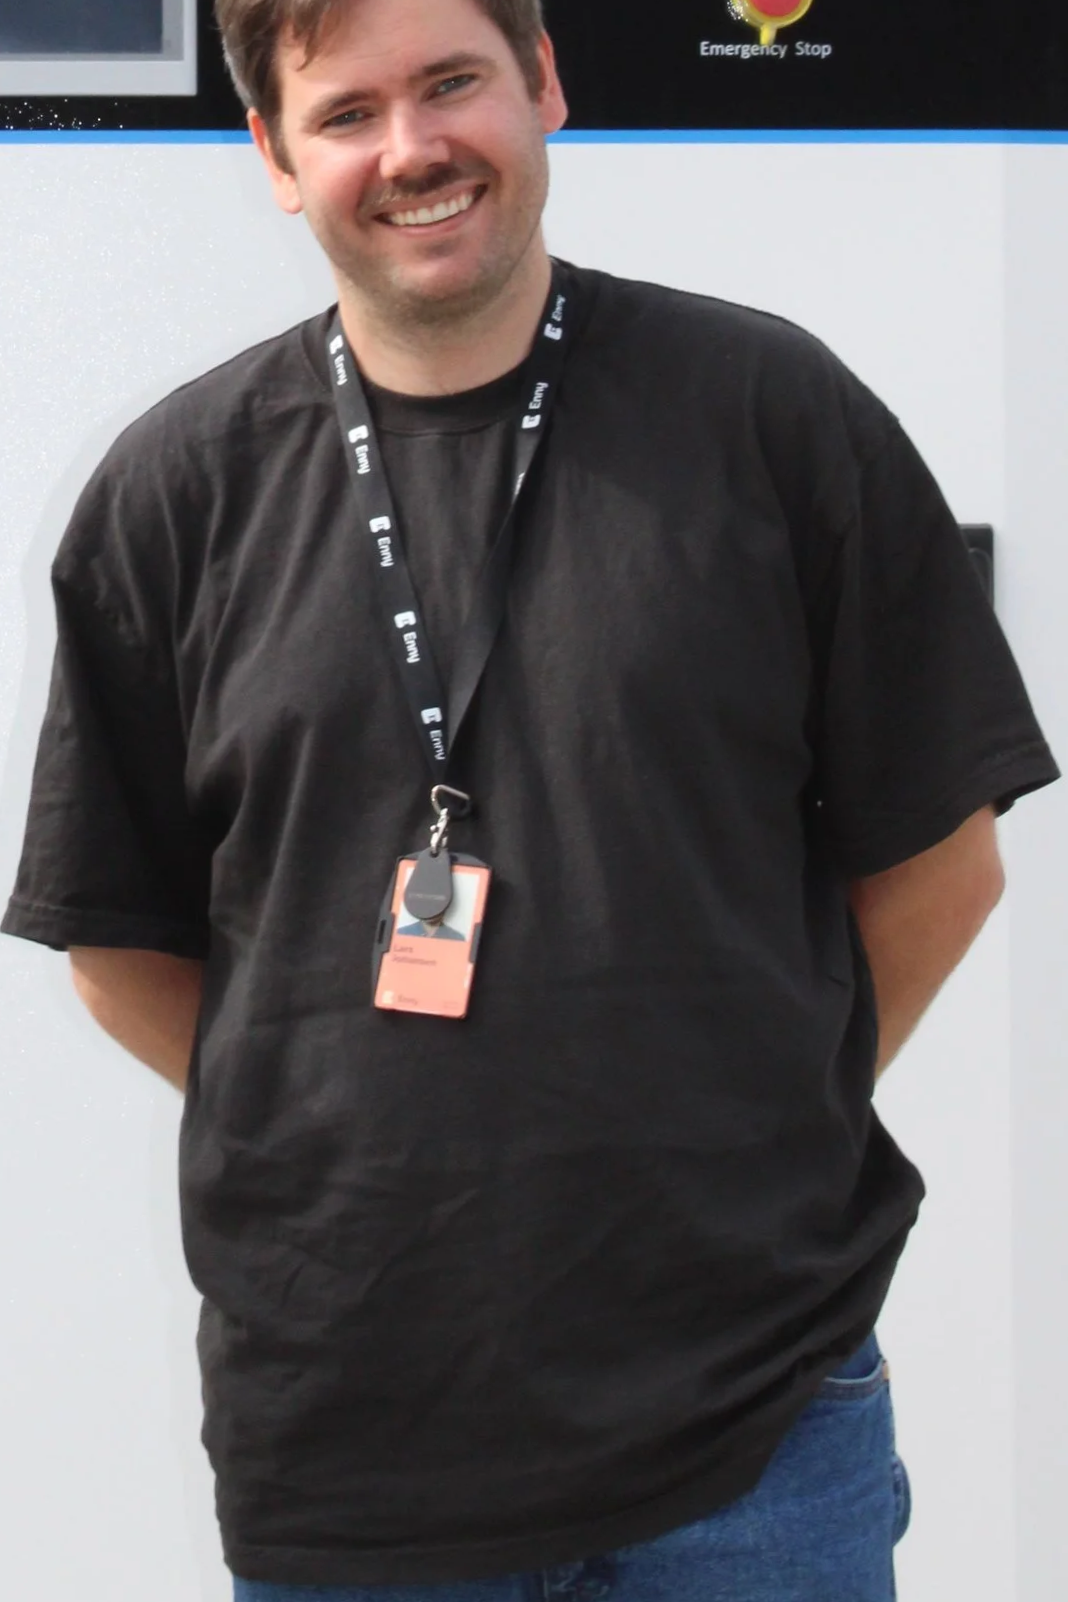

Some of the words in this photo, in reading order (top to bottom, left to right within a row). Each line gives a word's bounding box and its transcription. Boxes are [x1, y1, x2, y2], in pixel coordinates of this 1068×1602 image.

[699, 41, 789, 60] Emergency
[795, 41, 833, 60] Stop
[334, 353, 348, 386] Enny
[528, 381, 549, 410] Enny
[355, 443, 371, 475] Enny
[377, 536, 394, 568] Enny
[402, 631, 421, 664] Enny
[429, 729, 446, 761] Enny
